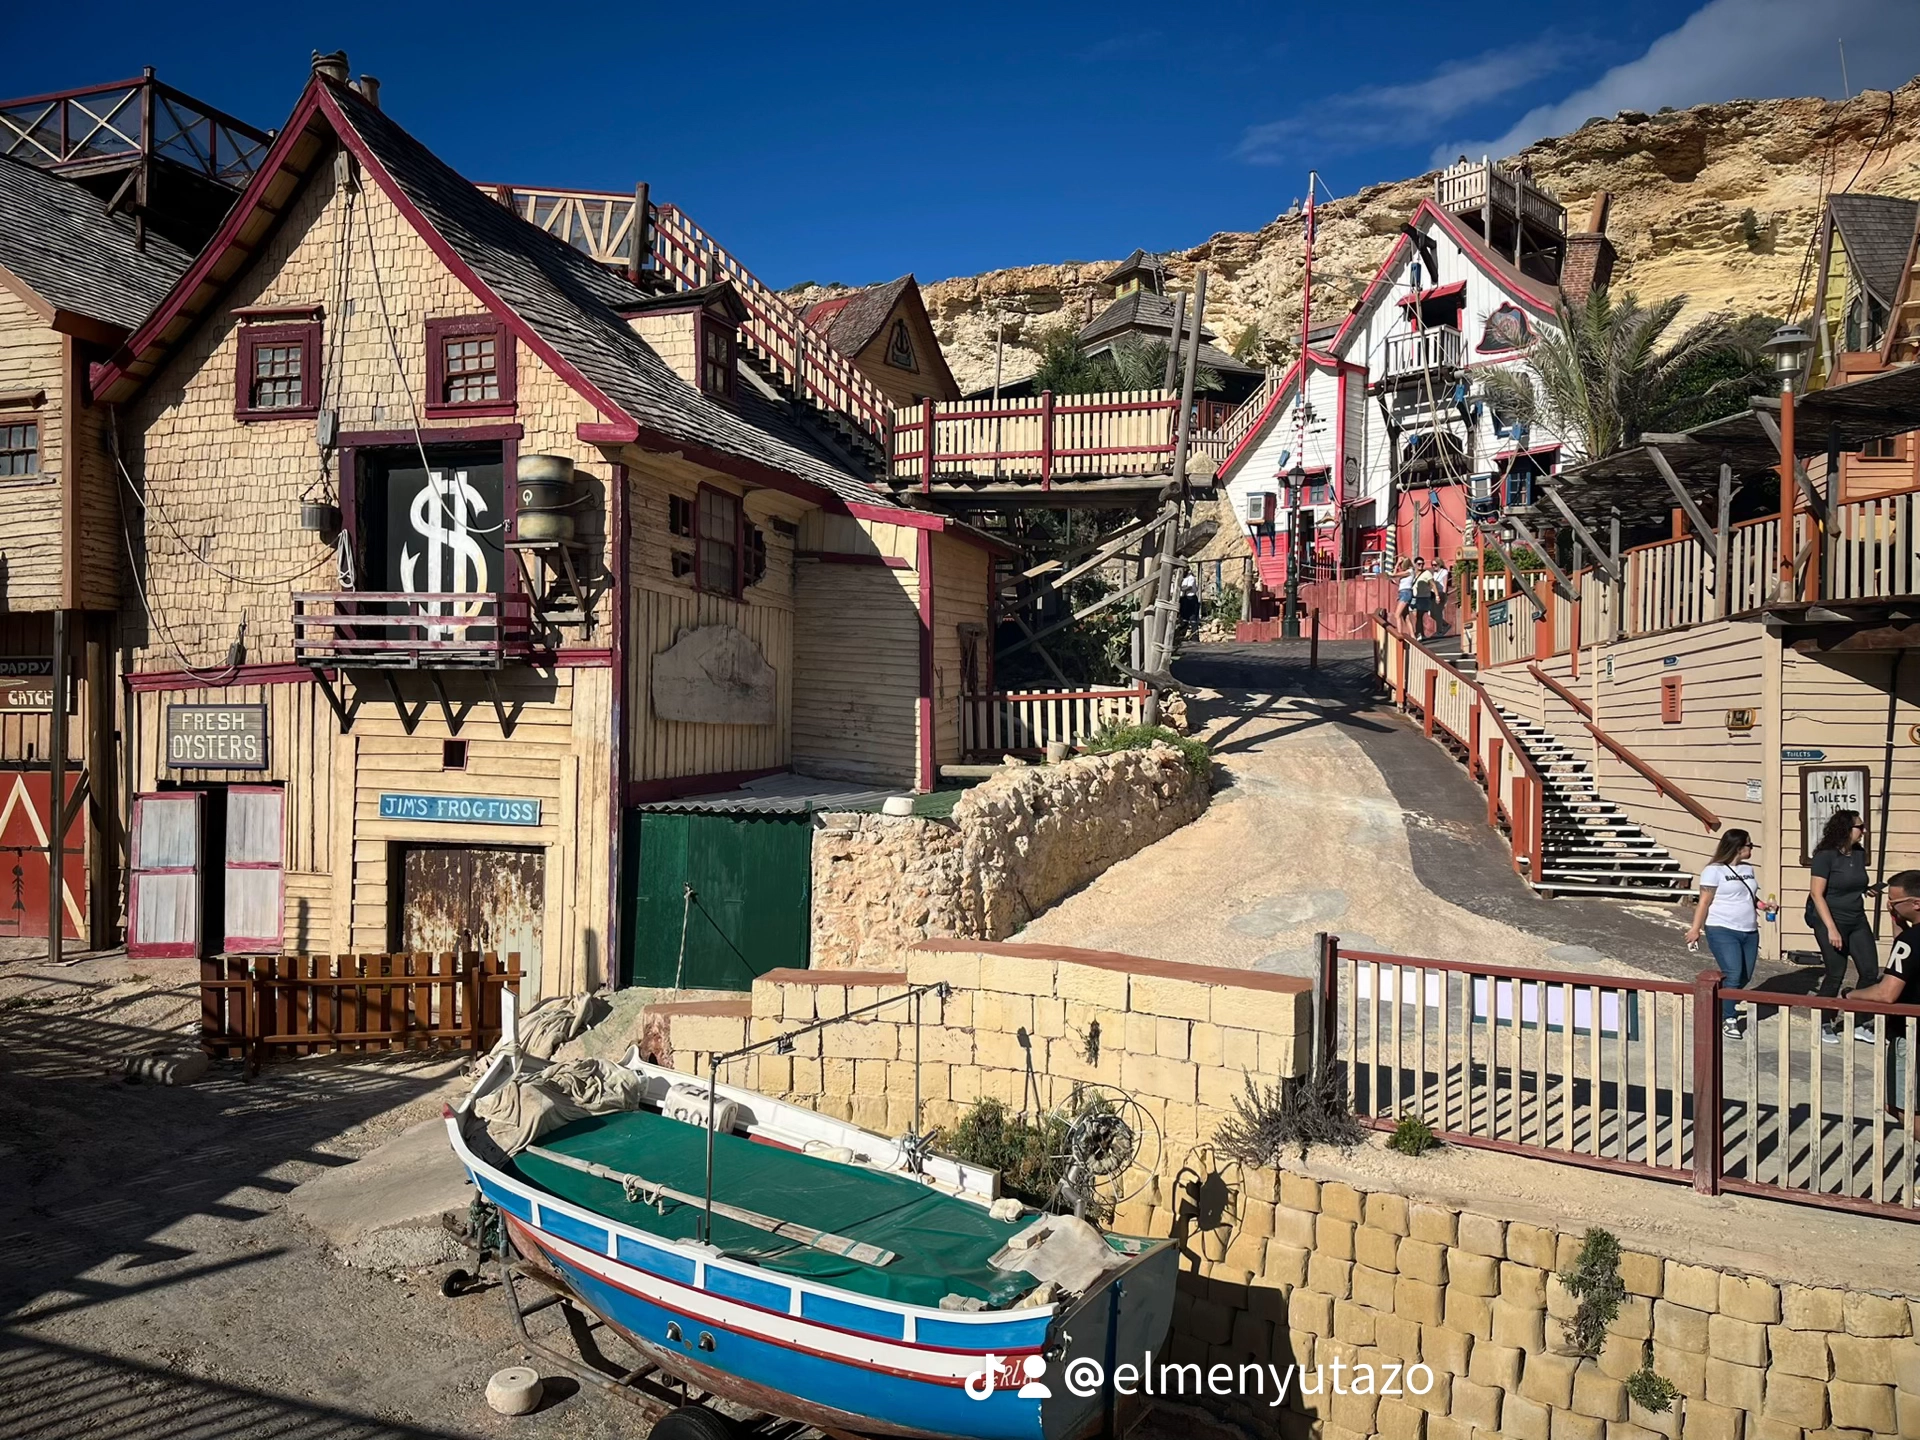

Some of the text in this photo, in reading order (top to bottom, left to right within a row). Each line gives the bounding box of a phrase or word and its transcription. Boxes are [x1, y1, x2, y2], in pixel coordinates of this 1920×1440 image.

[0, 662, 51, 674] PAPPY
[8, 690, 54, 705] CATCH
[182, 712, 245, 731] FRESH
[173, 734, 257, 761] OYSTERS
[1824, 775, 1848, 790] PAY
[385, 797, 428, 816] JIM'S
[1886, 940, 1912, 974] R
